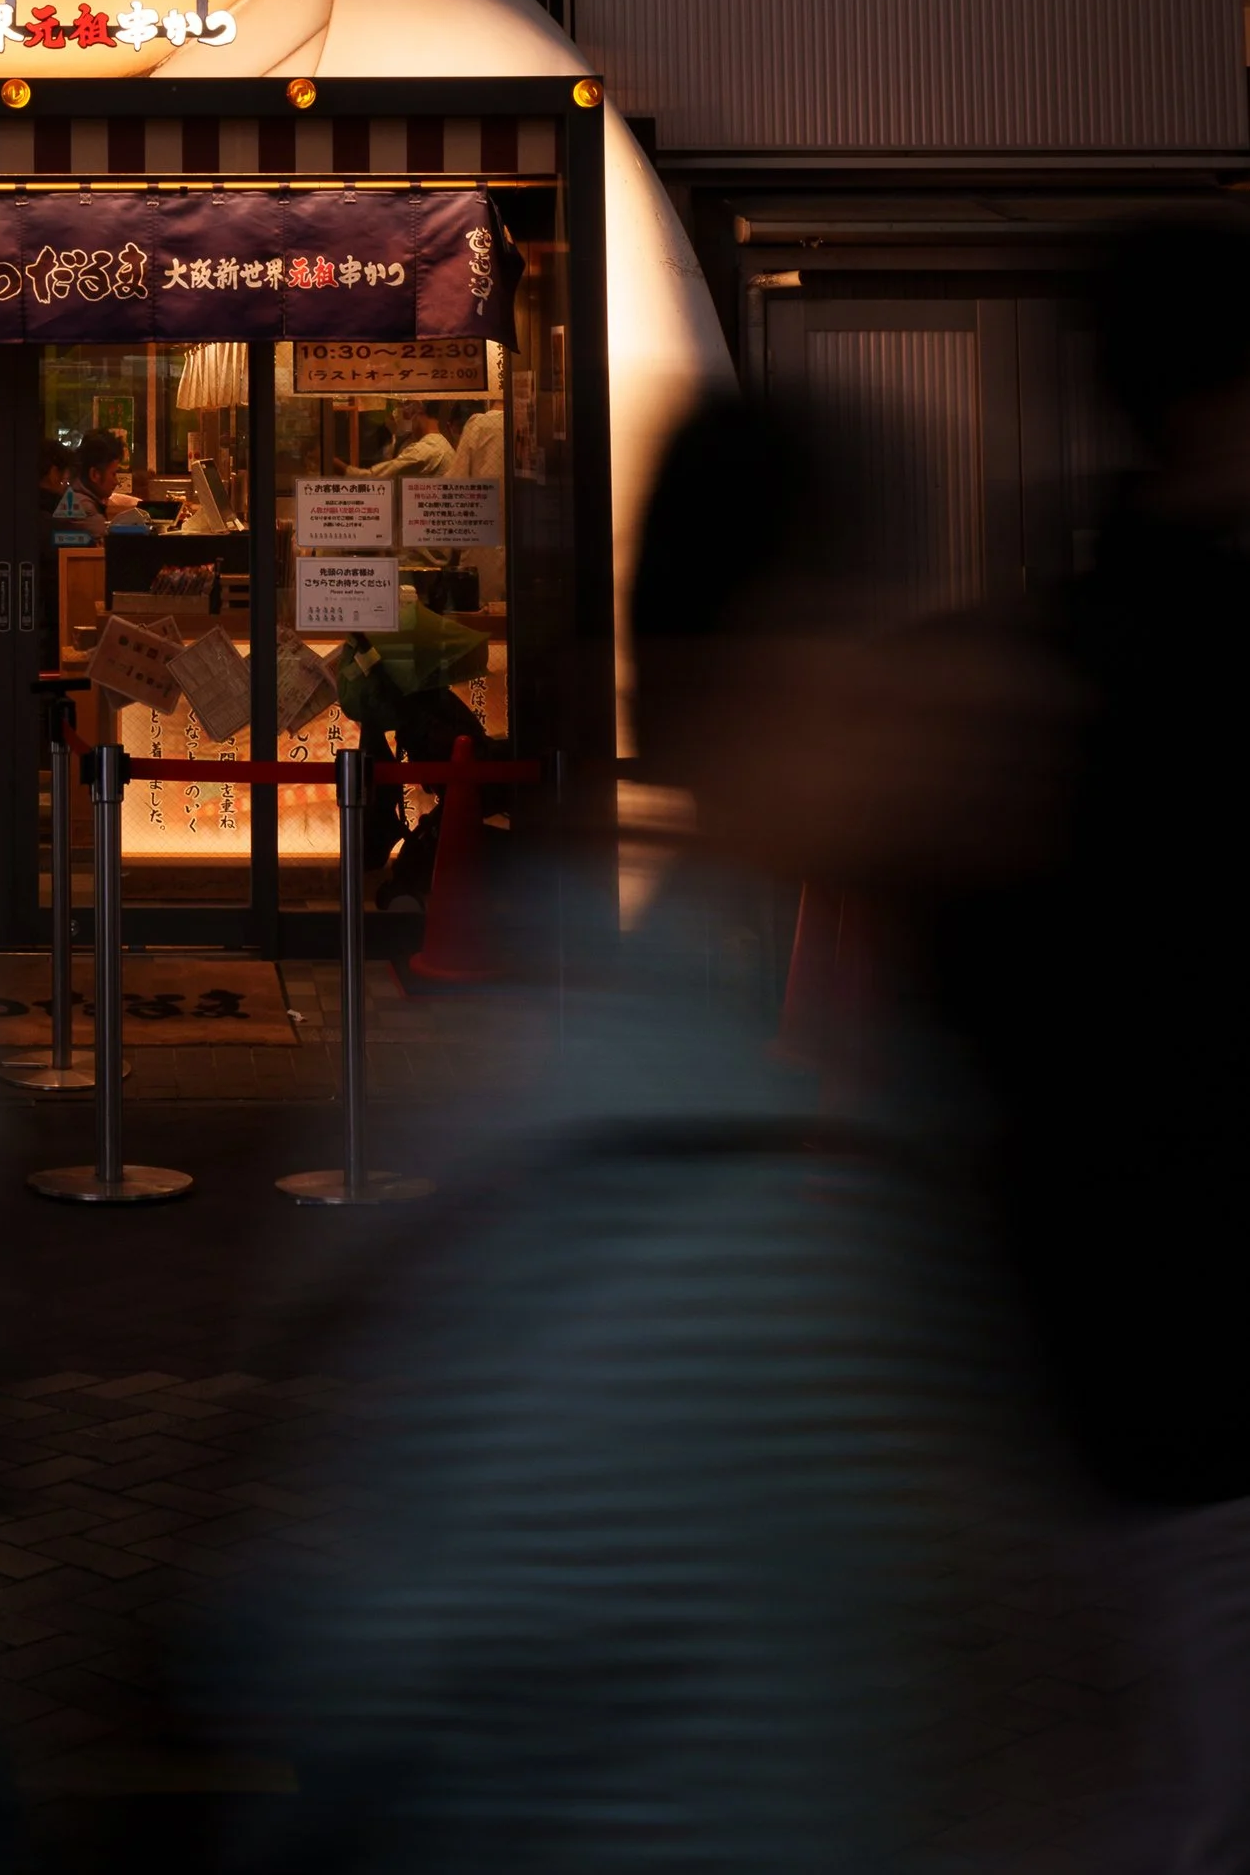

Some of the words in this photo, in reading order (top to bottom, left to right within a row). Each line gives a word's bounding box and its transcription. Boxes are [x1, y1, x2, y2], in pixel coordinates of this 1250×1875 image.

[162, 254, 406, 292] 大阪新世界元祖串かつ
[314, 483, 375, 494] お客様へお願い
[149, 709, 166, 832] とり着ました。
[185, 709, 201, 833] くなっとのいく
